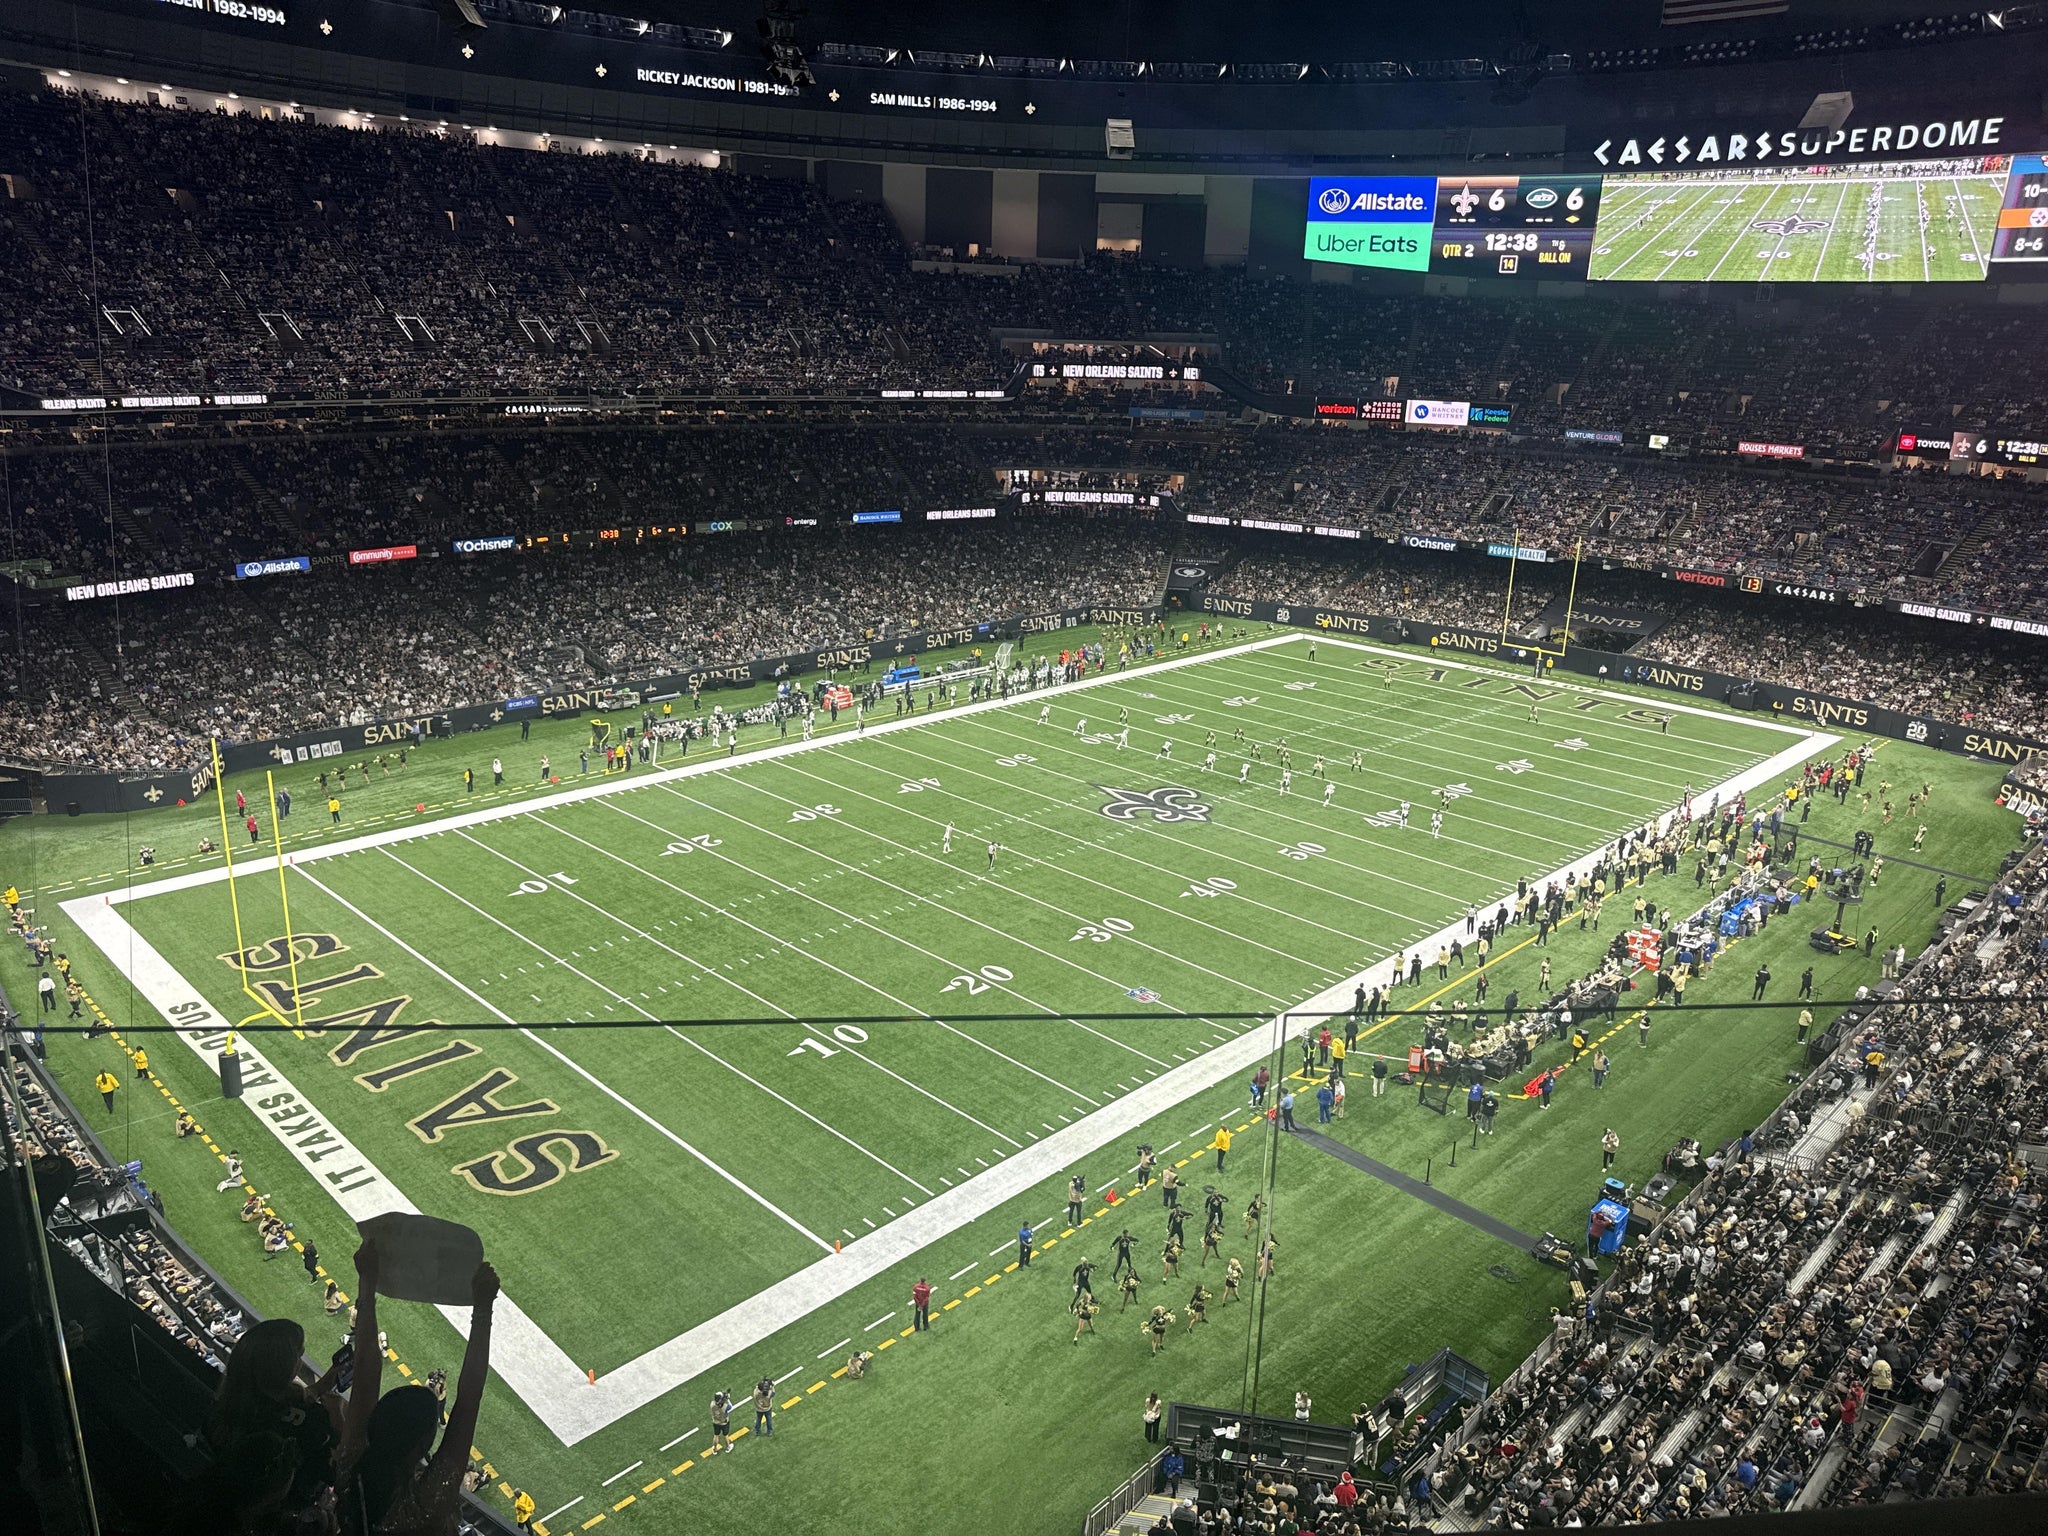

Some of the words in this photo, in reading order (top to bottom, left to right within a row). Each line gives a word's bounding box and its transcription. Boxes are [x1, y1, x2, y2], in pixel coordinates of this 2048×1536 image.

[213, 0, 286, 25] 1982-1994
[637, 68, 680, 86] RICKEY
[682, 73, 736, 91] JACKSON
[870, 92, 896, 106] SAM
[898, 94, 932, 108] MILLS
[938, 97, 997, 113] 1986-1994
[1593, 131, 1773, 167] CAESARS
[1778, 117, 2004, 157] SUPERDOME
[1351, 193, 1424, 211] Allstate
[1488, 188, 1506, 212] 6
[1566, 187, 1584, 211] 6
[1317, 234, 1366, 252] Uber
[1369, 235, 1418, 253] Eats
[1485, 233, 1538, 252] 12:38
[2014, 238, 2044, 252] 8-6
[1442, 244, 1461, 259] QTR
[1465, 244, 1475, 258] 2
[1538, 252, 1558, 264] BALL
[1559, 252, 1571, 264] ON
[1503, 258, 1514, 270] 14
[1062, 364, 1084, 378] NEW
[1085, 364, 1126, 378] ORLEANS
[1127, 365, 1163, 379] SAINTS
[214, 395, 231, 405] NEW
[232, 395, 261, 405] ORLEANS
[314, 391, 349, 401] SAINTS
[390, 389, 422, 399] SAINTS
[77, 397, 107, 409] SAINTS
[122, 397, 139, 408] NEW
[140, 396, 173, 408] ORLEANS
[173, 396, 200, 407] SAINTS
[1317, 403, 1356, 414] verizon
[162, 413, 199, 424] SAINTS
[1484, 415, 1509, 423] Federal
[1485, 408, 1510, 416] Keesler
[1566, 430, 1595, 440] VENTURE
[1595, 433, 1621, 442] GLOBAL
[1738, 442, 1766, 453] ROUSES
[1767, 445, 1802, 456] MARKETS
[1916, 439, 1951, 450] TOYOTA
[1976, 440, 1987, 454] 6
[2006, 441, 2039, 455] 12:38
[1044, 492, 1063, 503] NEW
[1064, 492, 1101, 504] ORLEANS
[1102, 492, 1134, 504] SAINTS
[793, 518, 817, 526] entergy
[926, 510, 941, 521] NEW
[942, 509, 971, 520] ORLEANS
[972, 508, 996, 519] SAINTS
[1207, 516, 1229, 526] SAINTS
[710, 521, 733, 531] COX
[1241, 519, 1253, 528] NEW
[1254, 520, 1279, 531] ORLEANS
[1280, 522, 1303, 533] SAINTS
[1315, 526, 1328, 535] NEW
[1329, 527, 1355, 538] ORLEANS
[563, 534, 569, 542] 6
[600, 529, 619, 539] 12:38
[638, 530, 643, 538] 2
[1373, 531, 1399, 540] SAINTS
[463, 538, 513, 552] Ochsner
[1409, 537, 1456, 551] Ochsner
[311, 554, 345, 566] SAINTS
[353, 549, 394, 563] Community
[1519, 549, 1545, 560] HEALTH
[262, 560, 301, 575] Allstate
[1622, 560, 1652, 571] SAINTS
[67, 585, 95, 601] NEW
[97, 578, 150, 597] ORLEANS
[151, 572, 194, 591] SAINTS
[1674, 571, 1724, 587] verizon
[1747, 578, 1758, 591] 13
[1775, 585, 1835, 602] CAESARS
[1847, 592, 1883, 605] SAINTS
[1203, 597, 1252, 615] SAINTS
[1900, 602, 1936, 618] RLEANS
[1937, 607, 1972, 623] SAINTS
[1090, 608, 1143, 627] SAINTS
[1277, 608, 1290, 620] 20
[1563, 610, 1643, 629] SAINTS
[1315, 613, 1369, 633] SAINTS
[1991, 617, 2012, 630] NEW
[1439, 631, 1498, 653] SAINTS
[1357, 658, 1680, 726] SAINTS
[1792, 696, 1868, 726] SAINTS
[1906, 722, 1928, 739] 20
[995, 753, 1037, 768] 50
[1495, 758, 1535, 775] 20
[907, 777, 942, 793] 40
[793, 803, 843, 822] 30
[666, 833, 723, 855] 20
[1278, 841, 1327, 862] 50
[519, 871, 579, 895] 10
[1190, 876, 1238, 899] 40
[1076, 917, 1134, 943] 30
[950, 965, 1014, 995] 20
[168, 1001, 212, 1028] US
[799, 1023, 869, 1059] 10
[216, 932, 620, 1196] SAINTS
[257, 1092, 344, 1163] TAKES
[325, 1164, 377, 1194] IT
